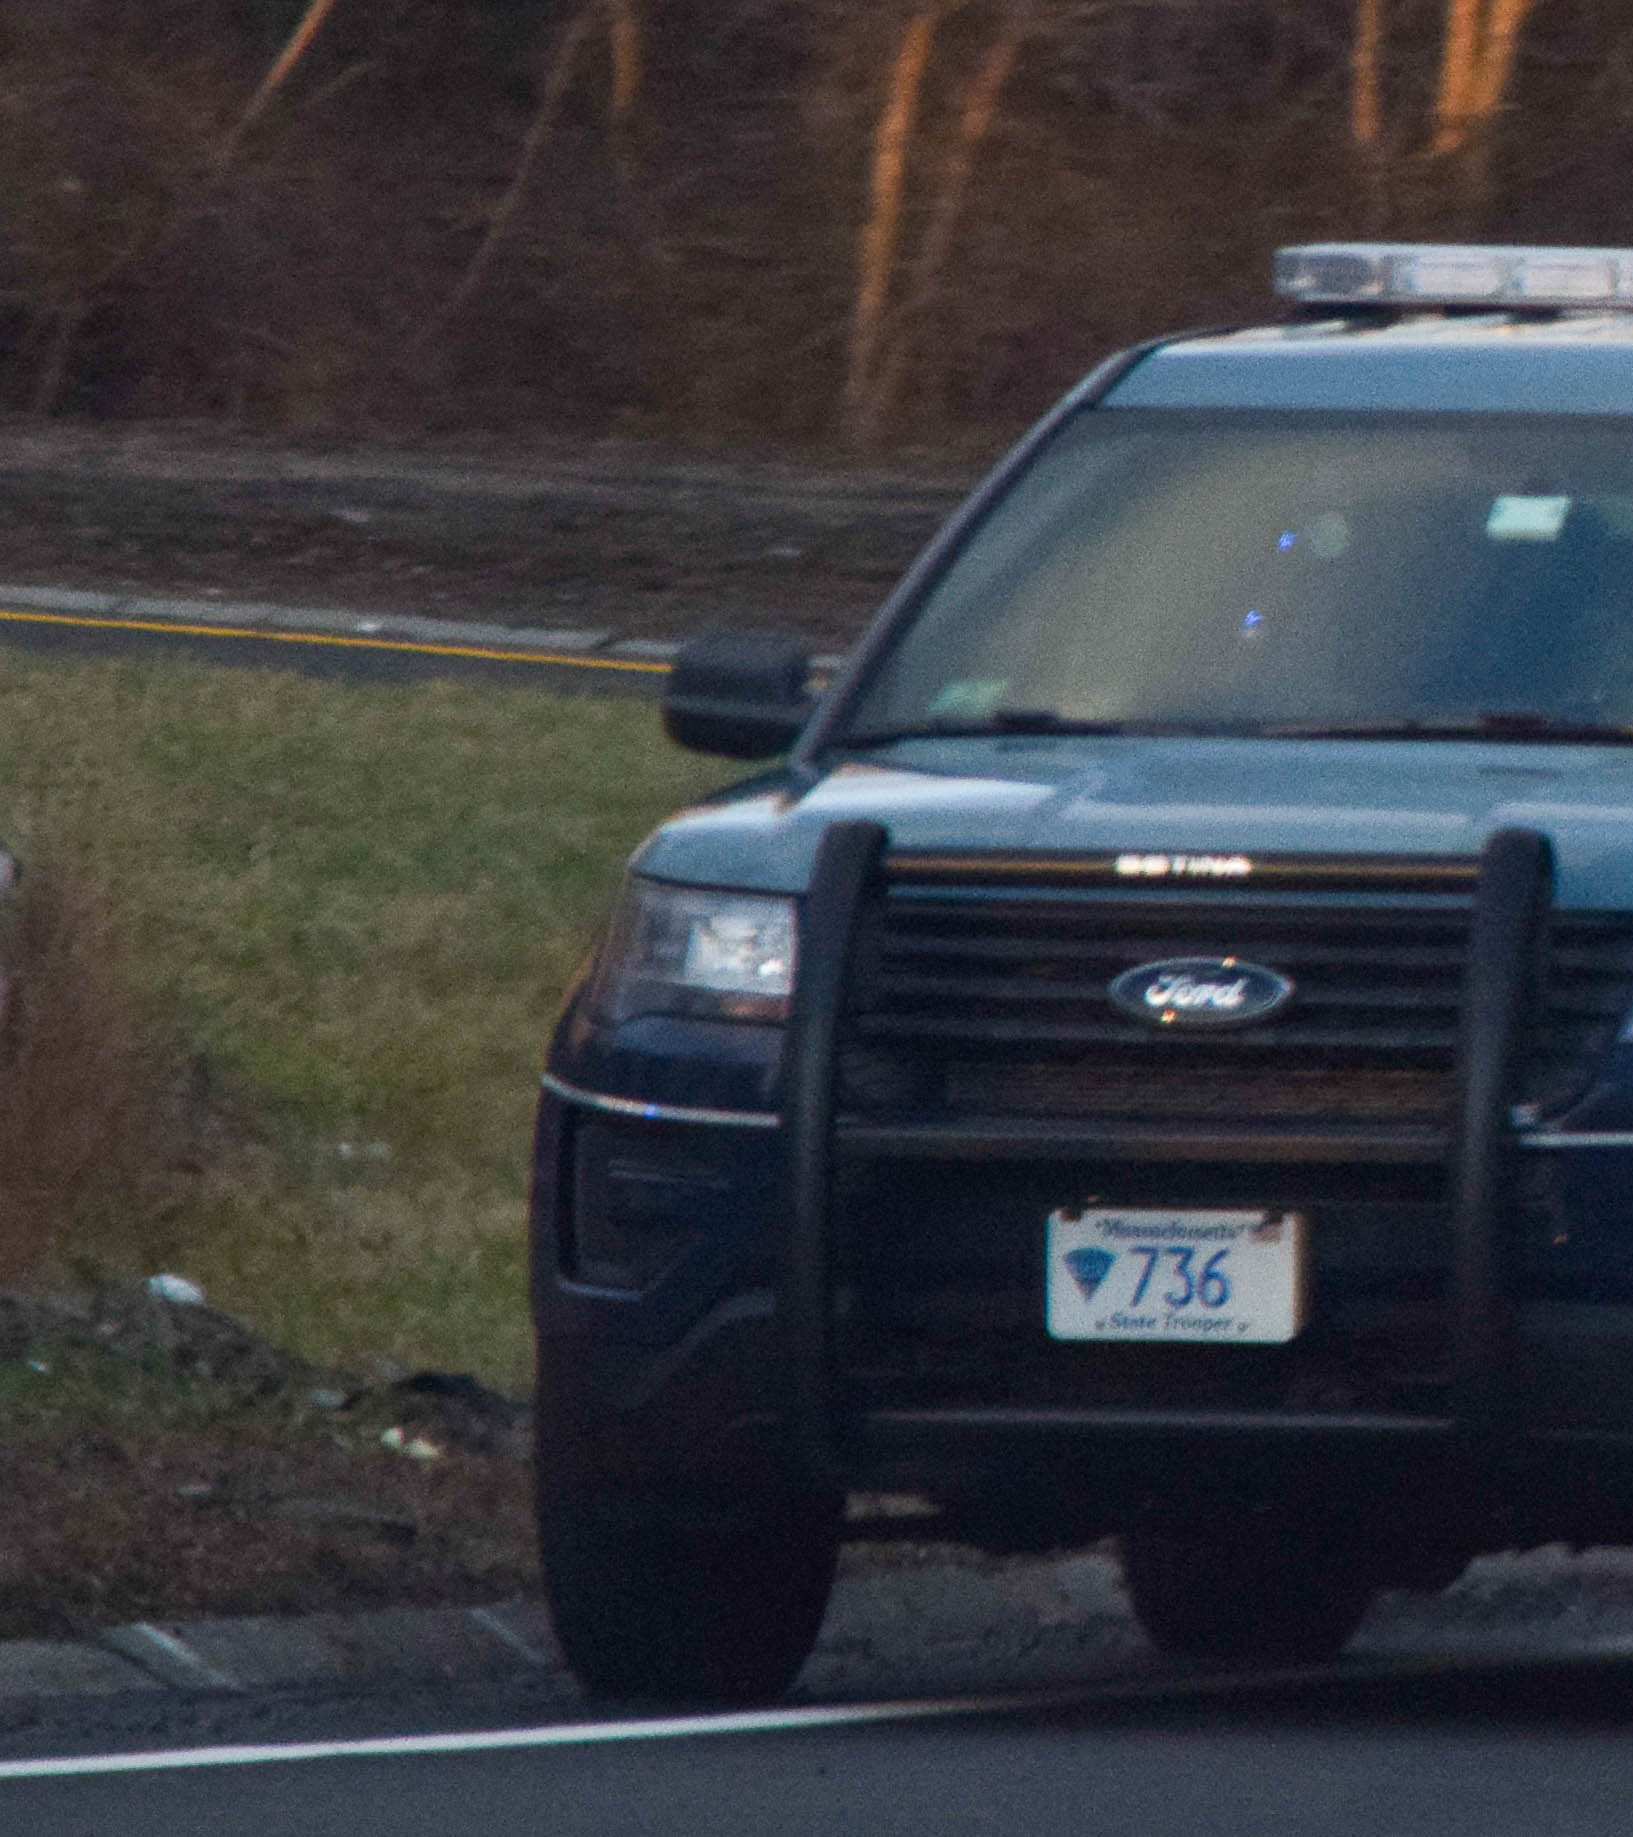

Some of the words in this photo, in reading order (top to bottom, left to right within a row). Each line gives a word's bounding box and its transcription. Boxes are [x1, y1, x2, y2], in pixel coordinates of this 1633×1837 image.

[1144, 973, 1249, 1007] Ford
[1127, 1245, 1233, 1309] 736
[1111, 1310, 1156, 1329] State
[1163, 1313, 1233, 1333] Trooper
